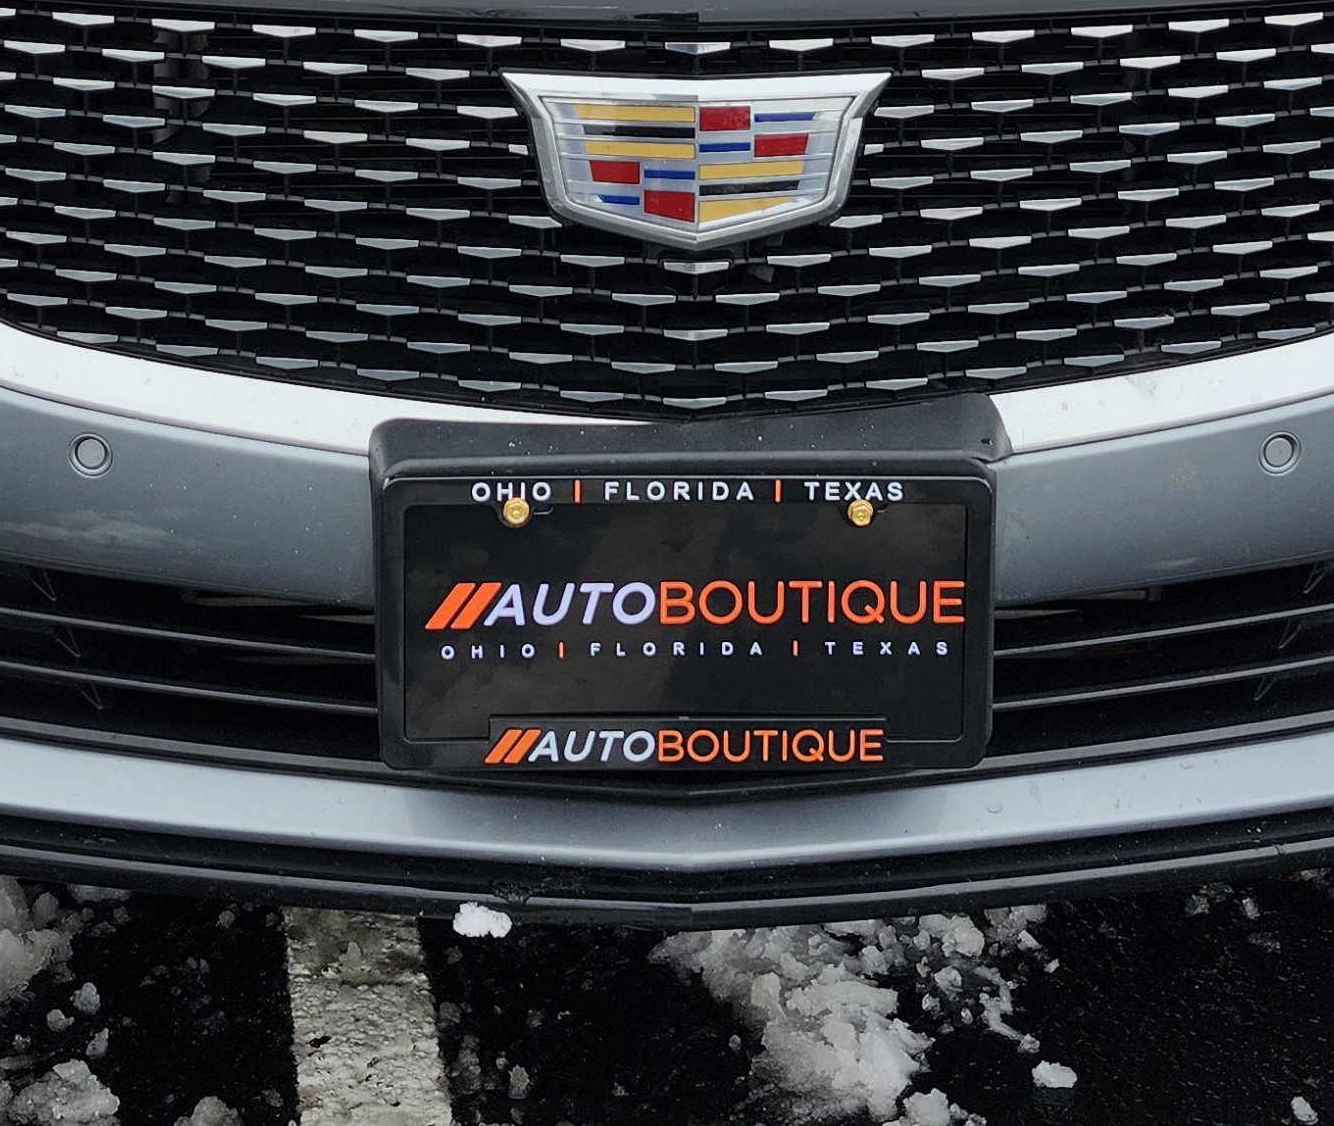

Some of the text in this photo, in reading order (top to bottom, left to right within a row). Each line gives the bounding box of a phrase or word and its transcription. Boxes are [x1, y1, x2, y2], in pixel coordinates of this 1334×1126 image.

[471, 480, 904, 503] OHIO FLORIDA TEXAS
[482, 579, 966, 628] AUTOBOUTIQUE
[440, 640, 949, 660] OHIO FLORIDA TEXAS
[527, 729, 885, 764] AUTOBOUTIQUE
